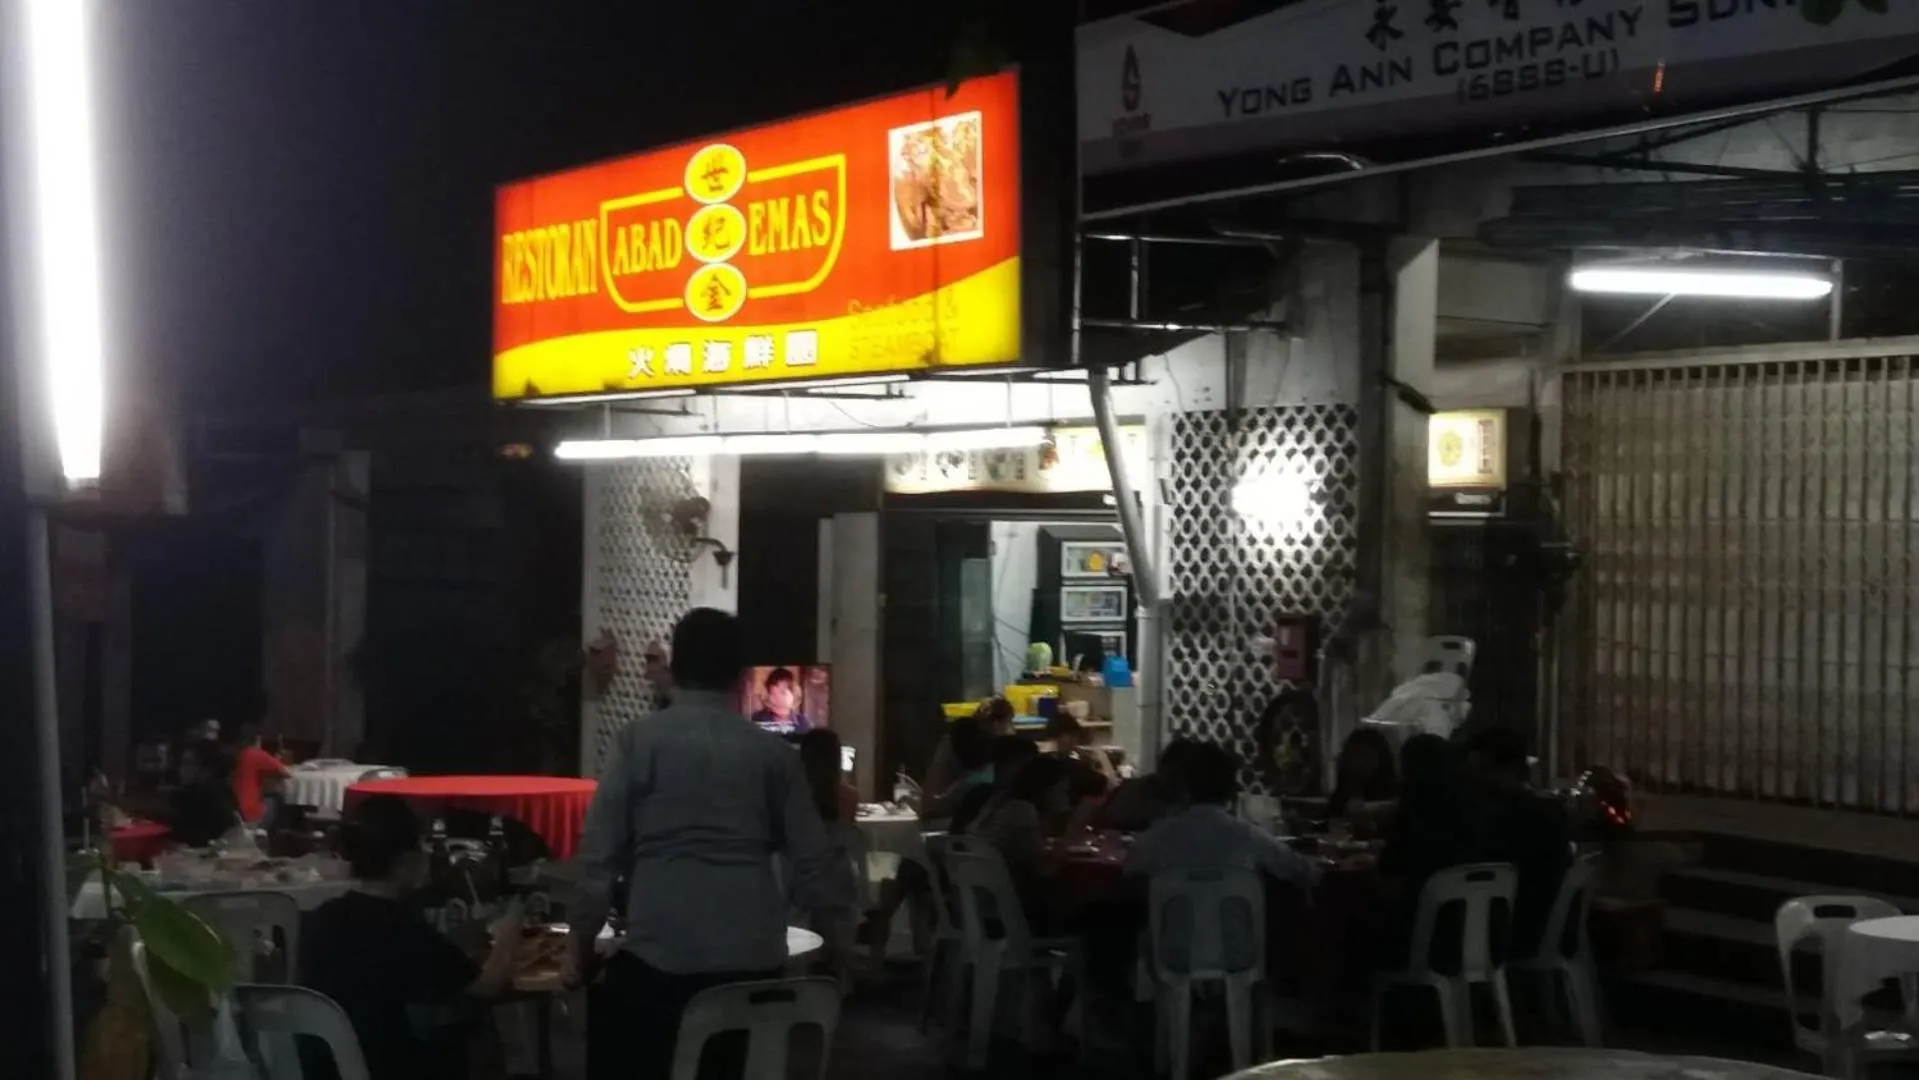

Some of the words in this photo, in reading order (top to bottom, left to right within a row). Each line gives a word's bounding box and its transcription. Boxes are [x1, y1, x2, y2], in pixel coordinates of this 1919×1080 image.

[1217, 77, 1313, 117] YONG
[1329, 56, 1412, 98] ANN
[1433, 7, 1642, 76] COMPANY
[501, 218, 599, 304] RESTORAN
[612, 218, 682, 275] ABAD
[747, 190, 832, 256] EMAS
